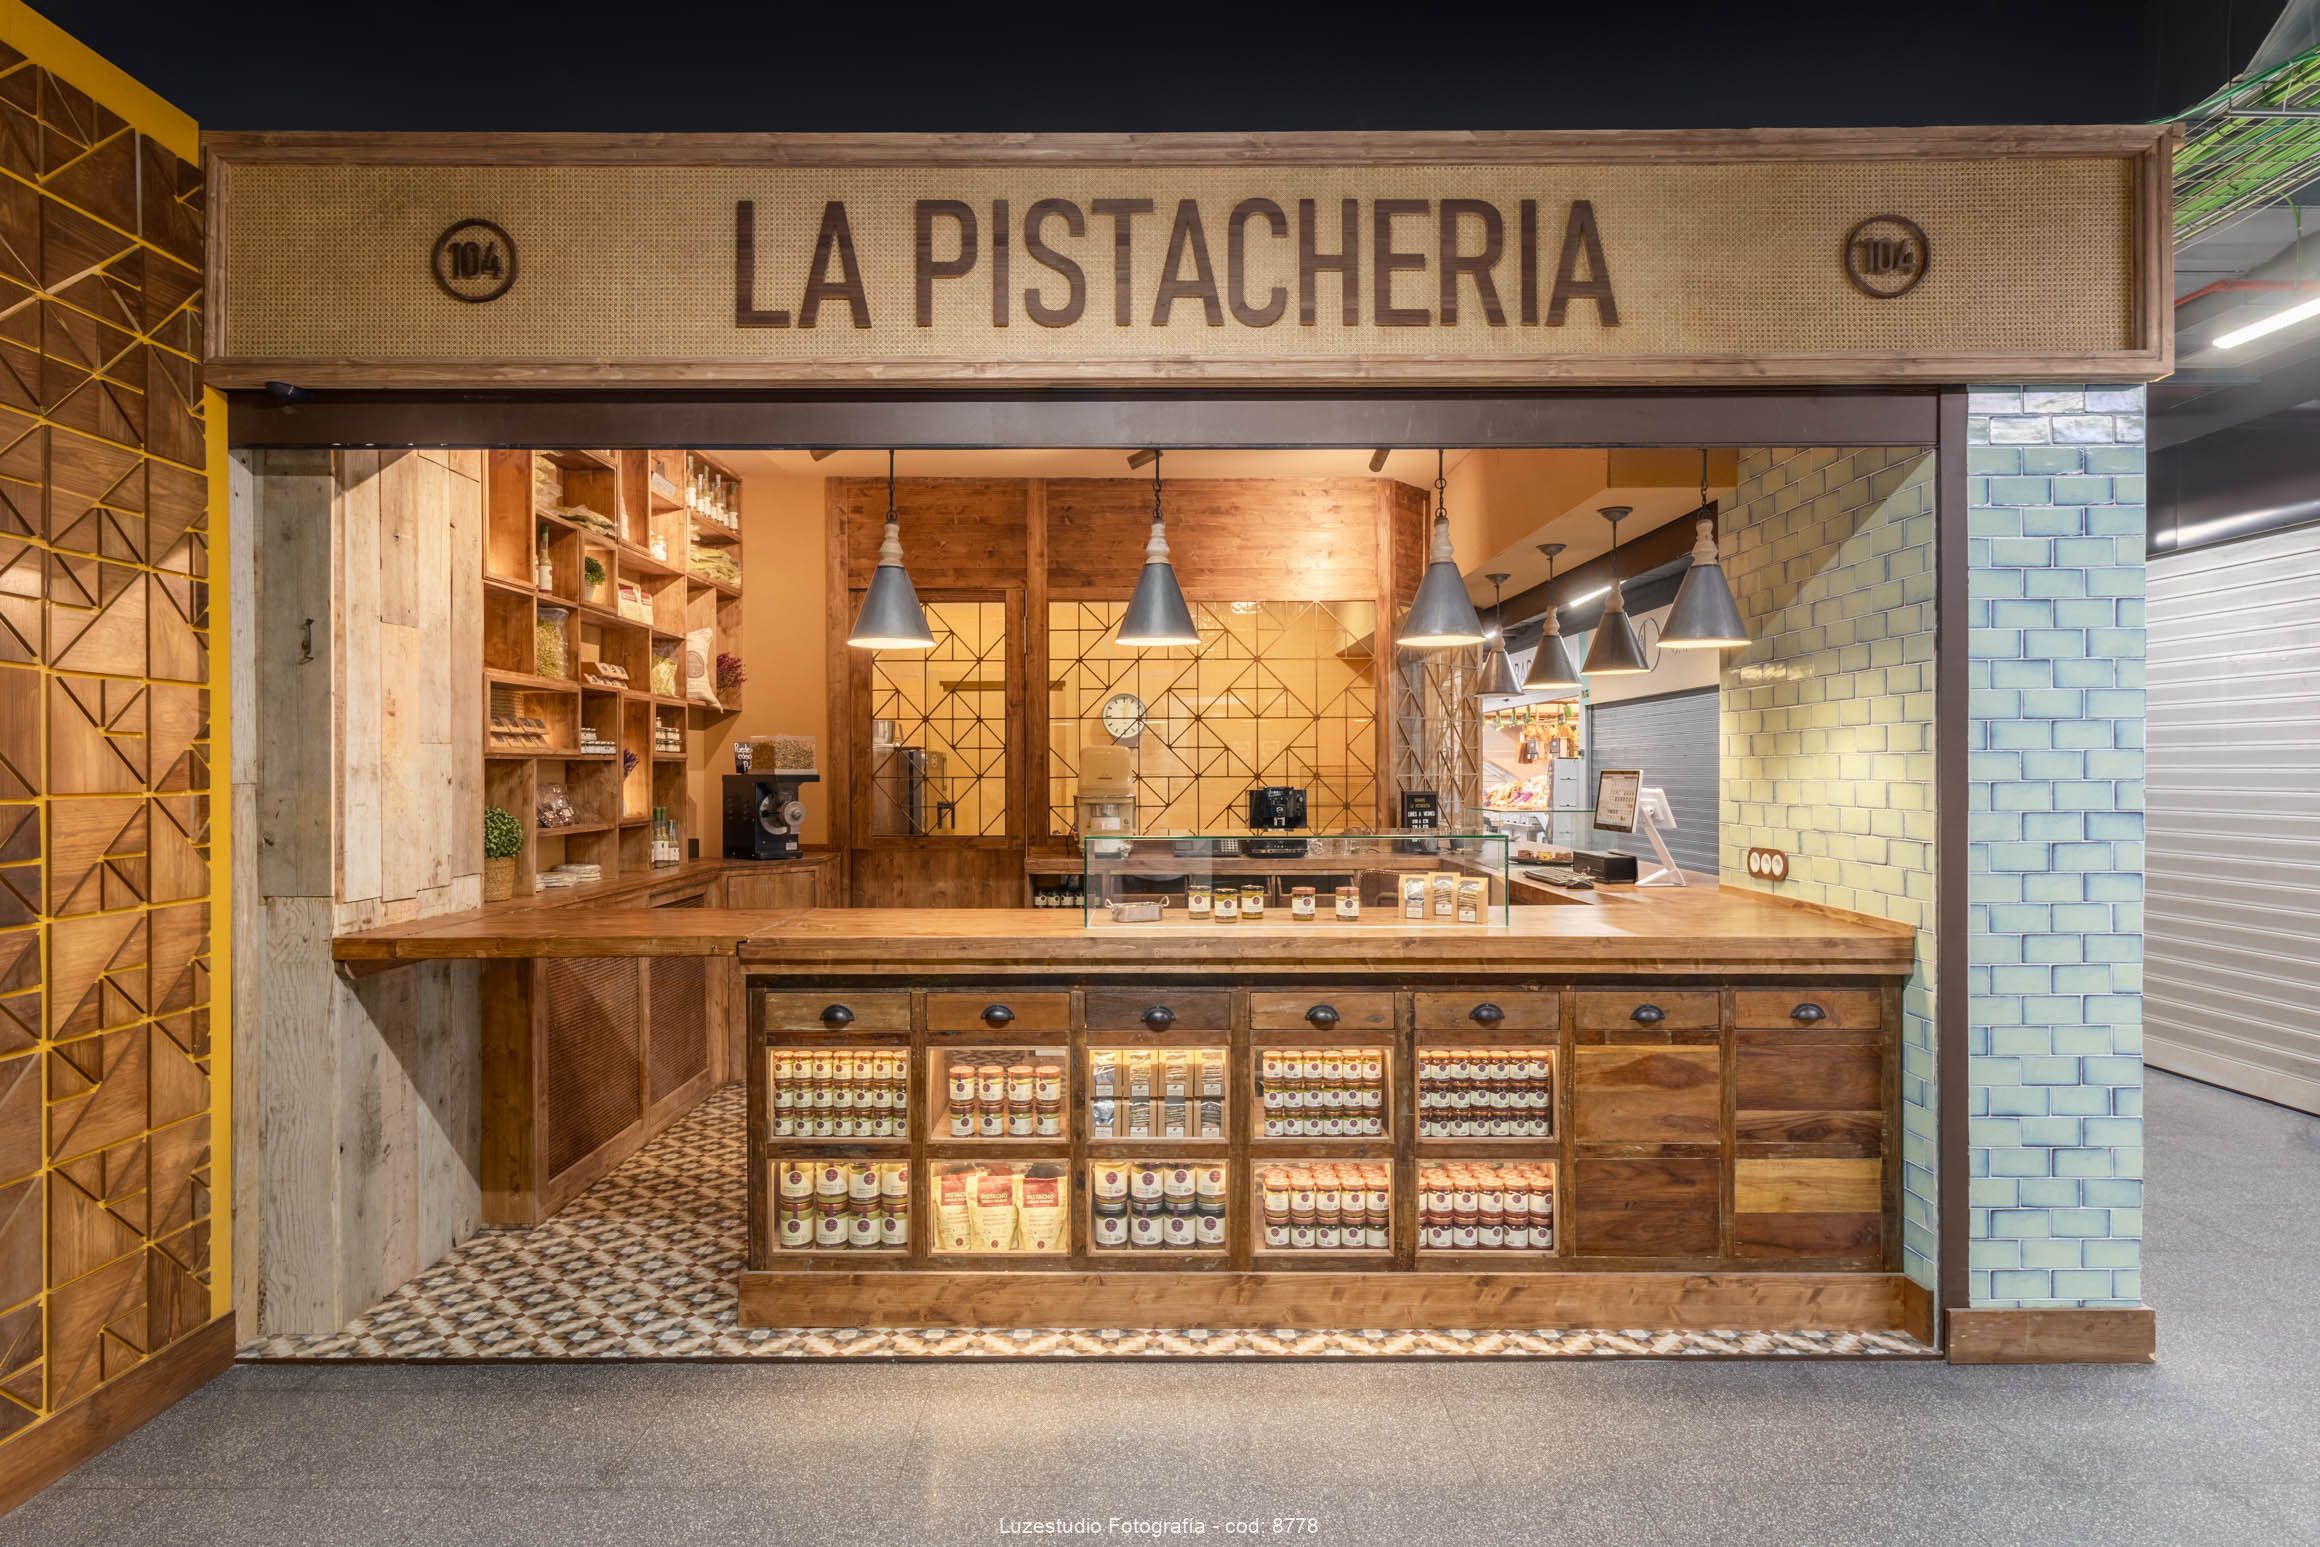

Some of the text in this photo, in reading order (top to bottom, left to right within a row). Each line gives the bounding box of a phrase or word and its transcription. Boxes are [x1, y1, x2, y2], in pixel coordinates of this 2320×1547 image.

[448, 241, 502, 280] 104
[736, 198, 1621, 329] LA PISTACHERIA
[1863, 238, 1916, 275] 104
